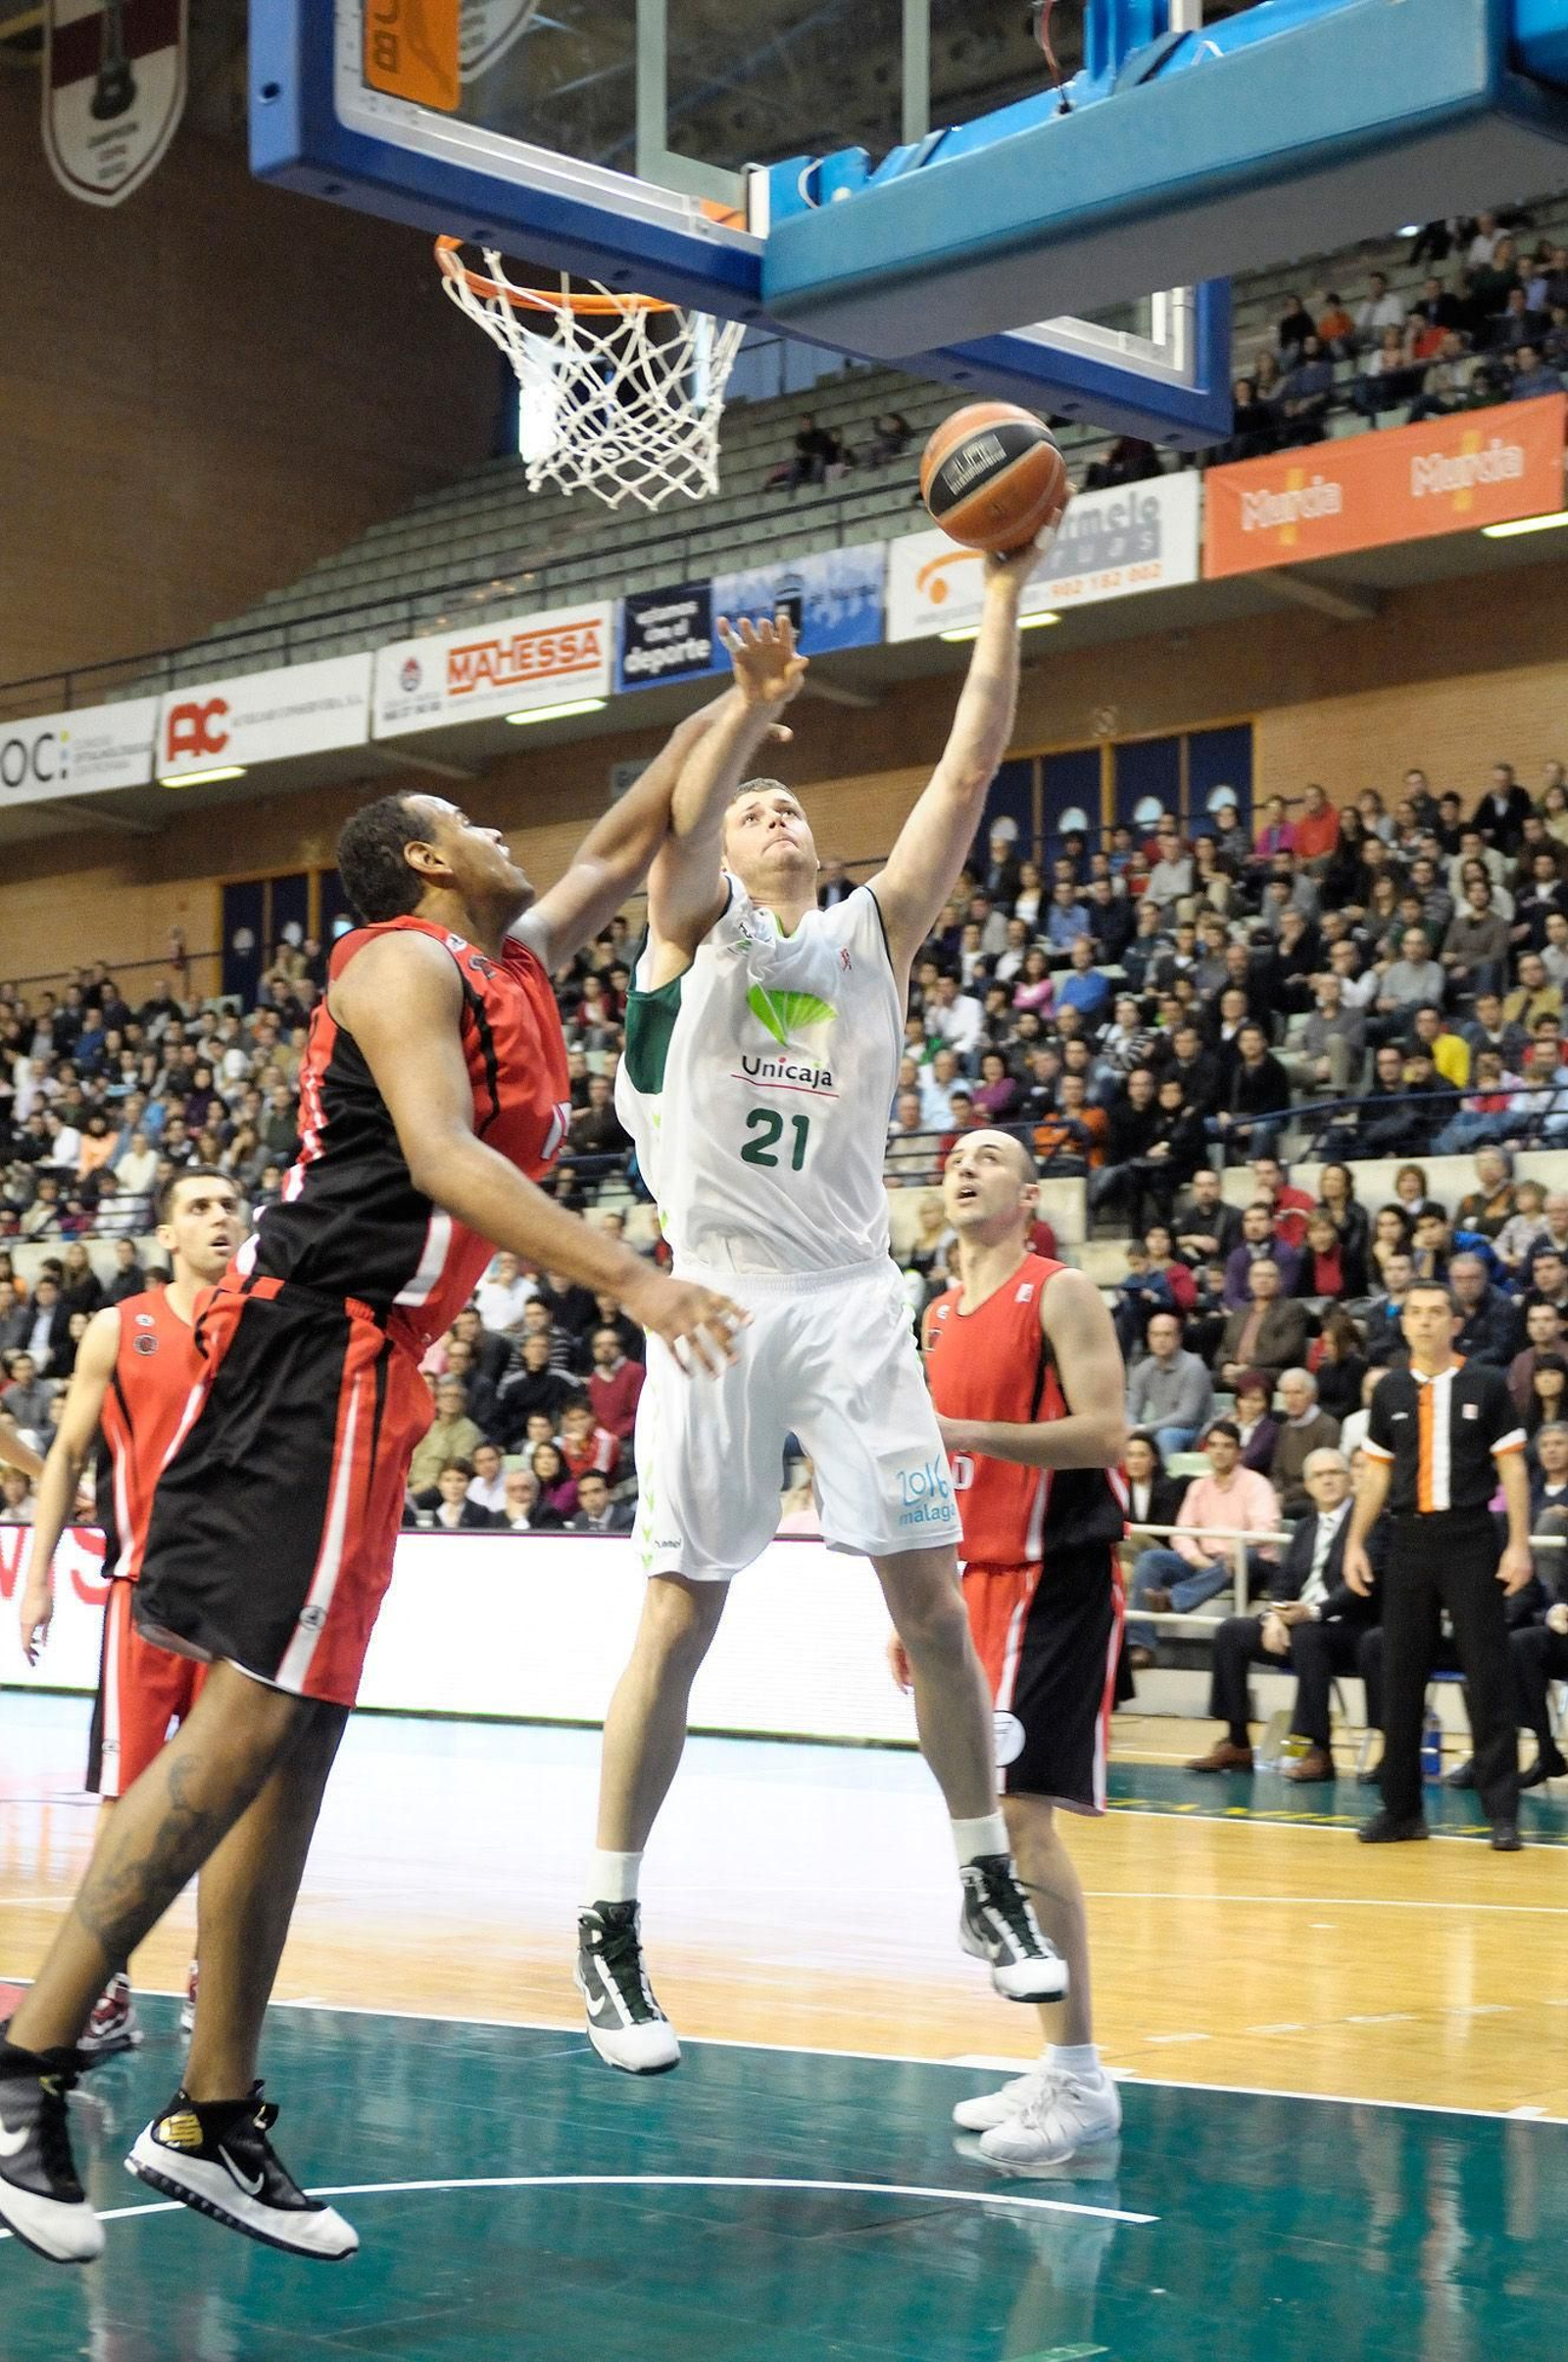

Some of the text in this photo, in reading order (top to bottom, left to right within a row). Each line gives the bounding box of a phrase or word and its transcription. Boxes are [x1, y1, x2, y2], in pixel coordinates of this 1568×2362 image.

[1064, 491, 1159, 539] rmelo
[624, 638, 711, 673] deporte
[741, 1055, 833, 1090] Unicaja
[741, 1107, 810, 1172] 21
[896, 1453, 950, 1506] 2016
